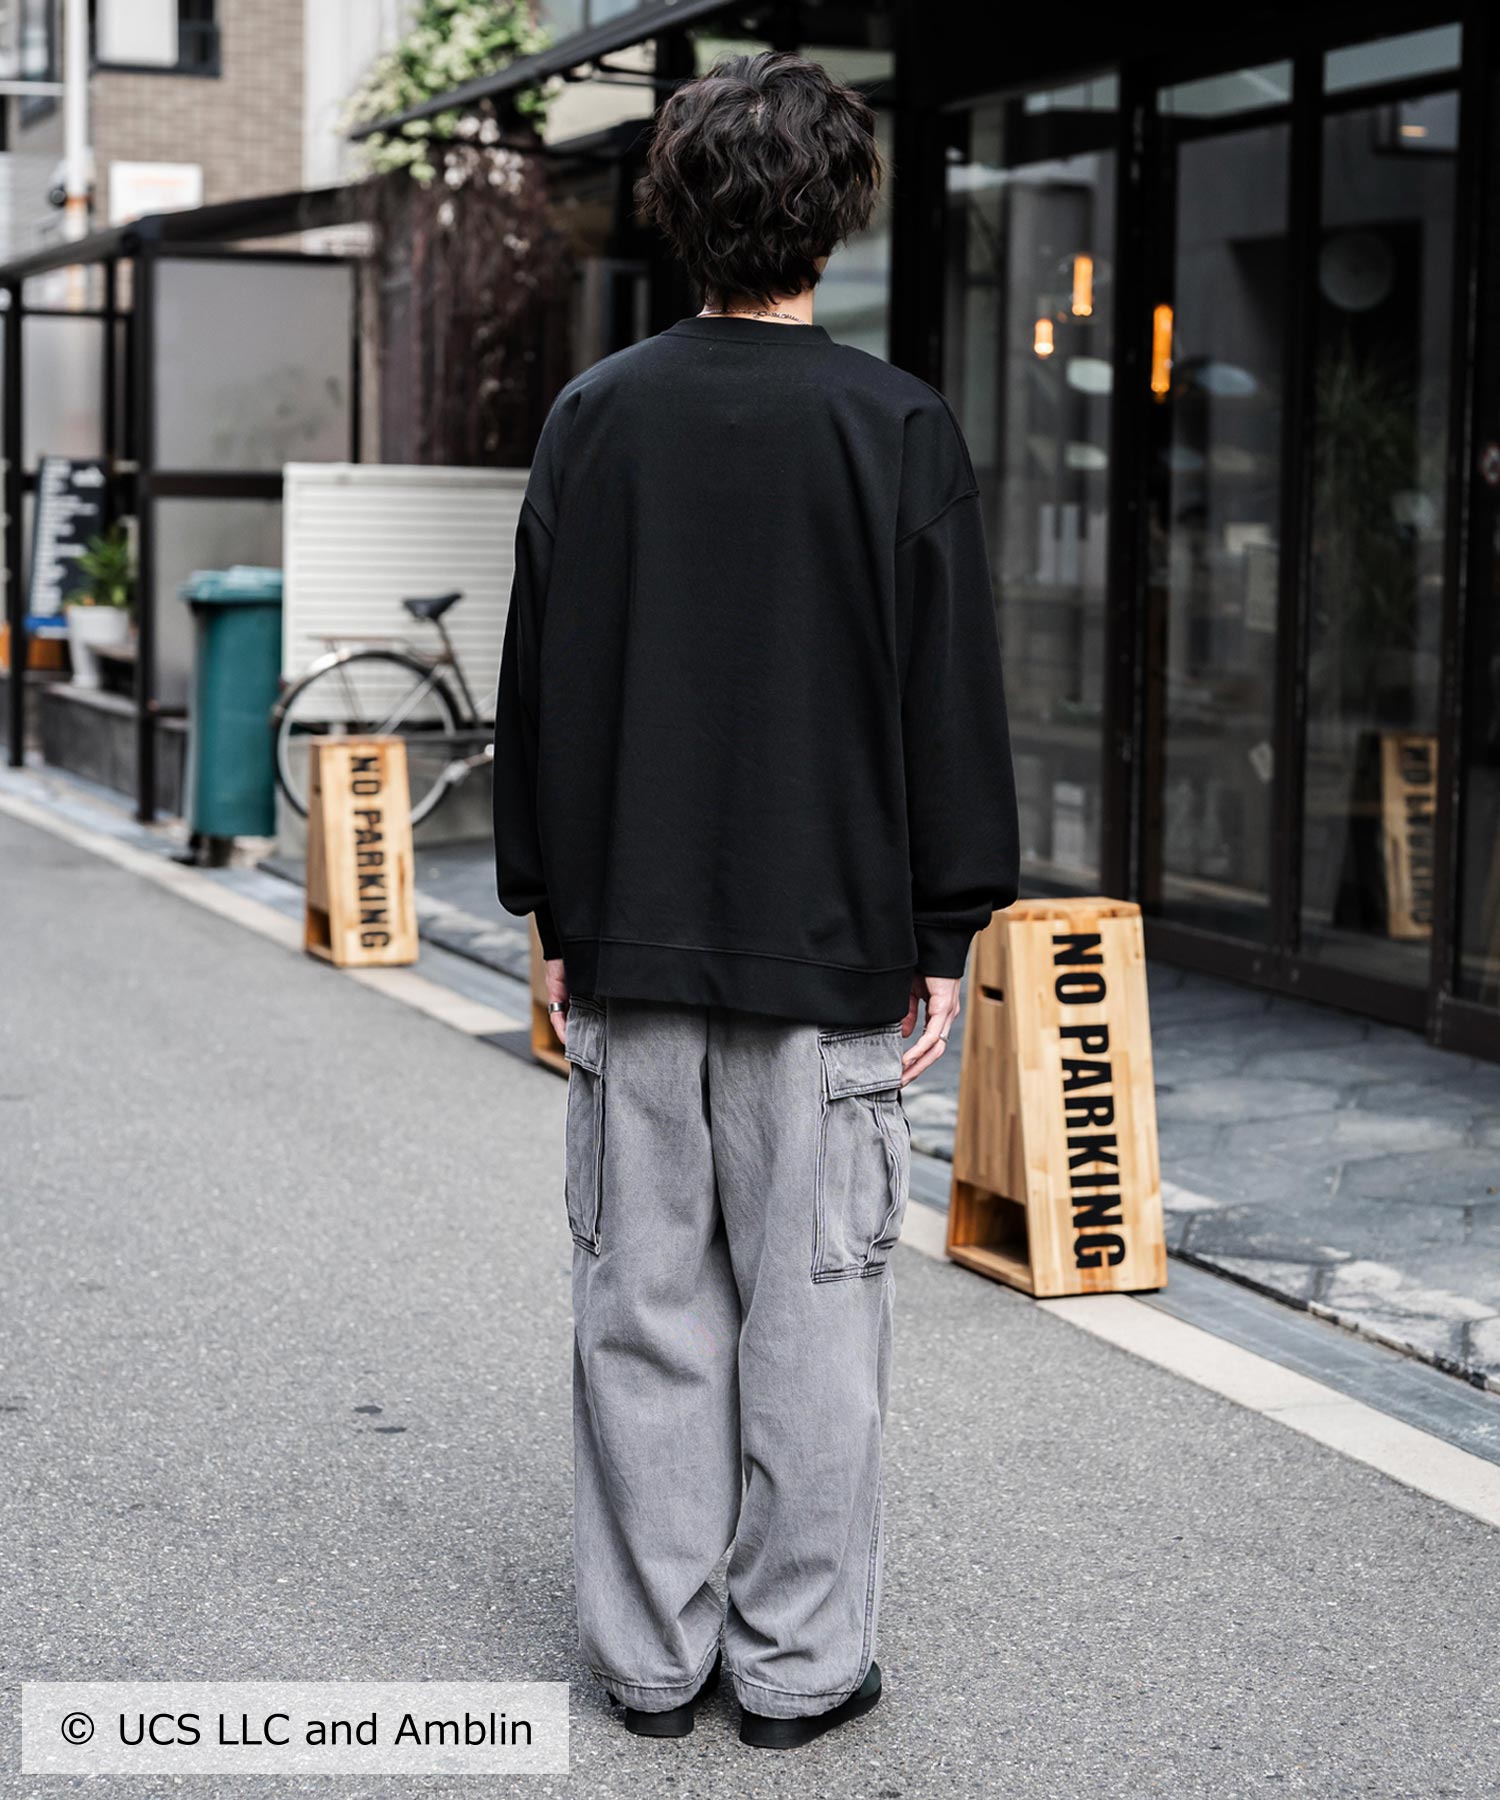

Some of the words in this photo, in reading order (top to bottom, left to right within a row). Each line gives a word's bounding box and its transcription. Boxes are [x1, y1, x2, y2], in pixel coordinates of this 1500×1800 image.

[351, 755, 381, 796] NO
[354, 809, 390, 949] PARKING
[1052, 933, 1107, 1005] NO
[1059, 1024, 1126, 1269] PARKING
